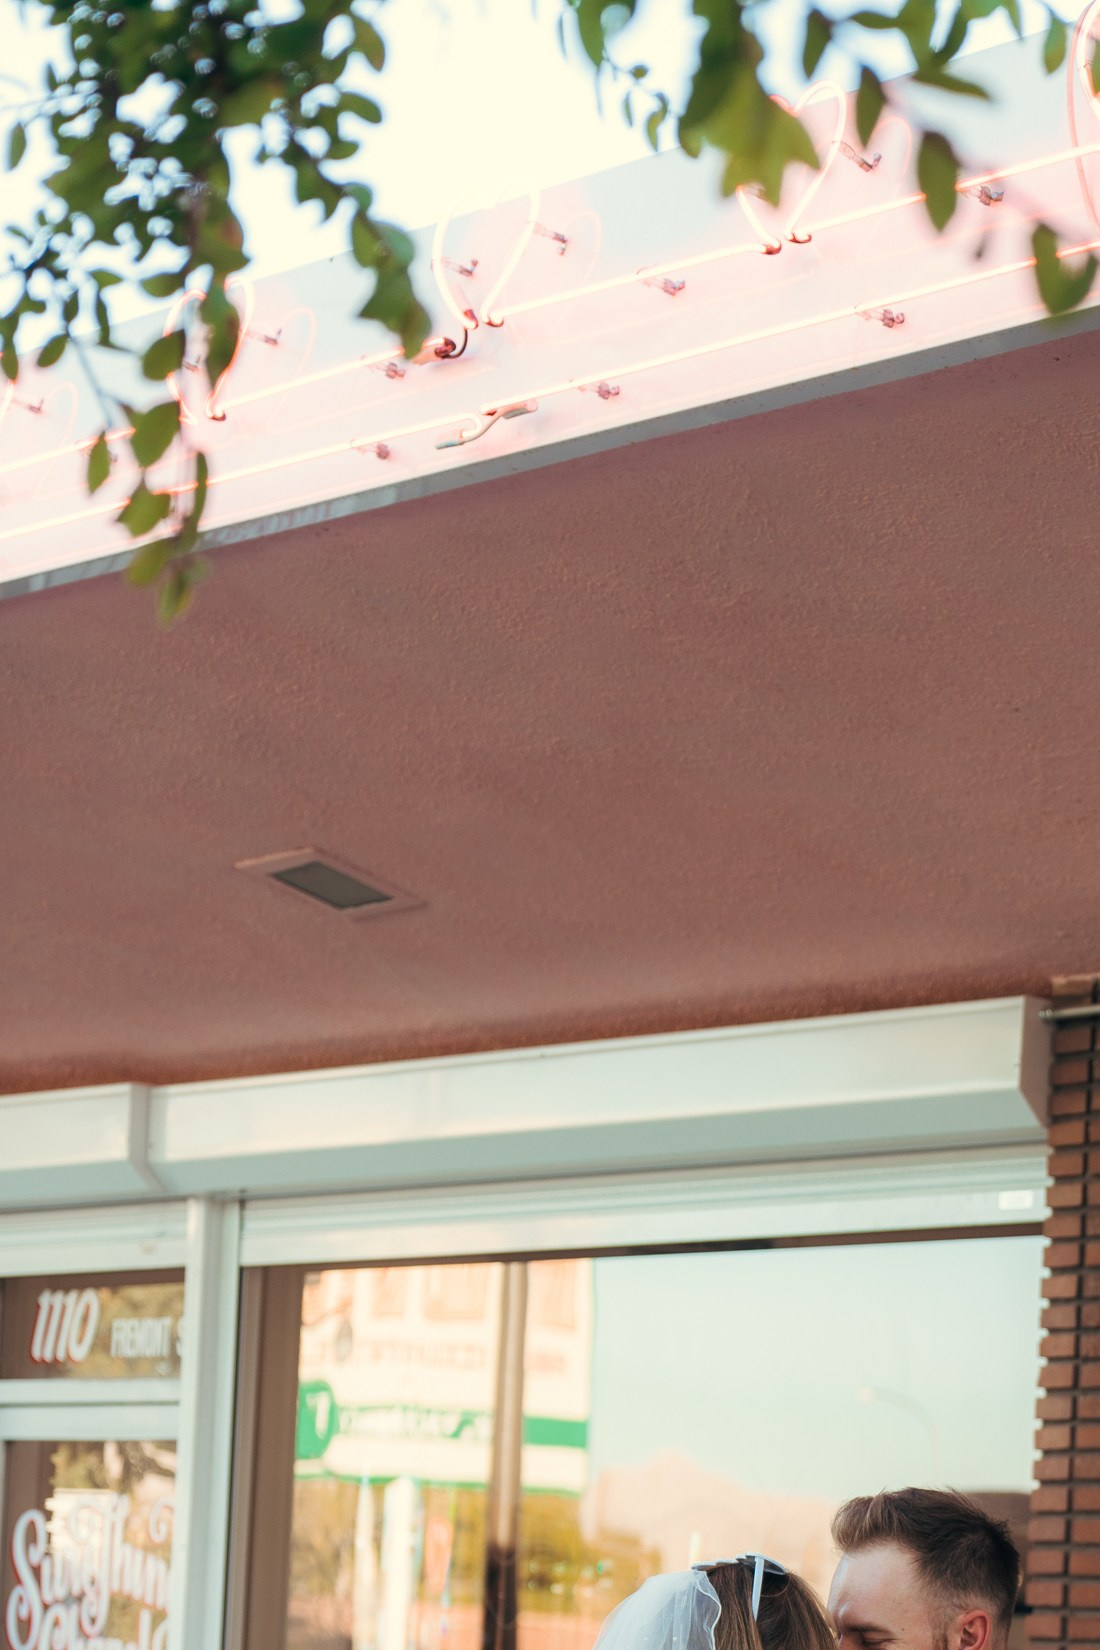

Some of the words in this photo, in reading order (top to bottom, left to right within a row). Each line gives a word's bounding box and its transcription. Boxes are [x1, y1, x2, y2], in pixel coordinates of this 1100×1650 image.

[30, 1287, 99, 1362] 1110
[110, 1316, 172, 1358] FREMONT
[69, 1494, 173, 1637] Thin
